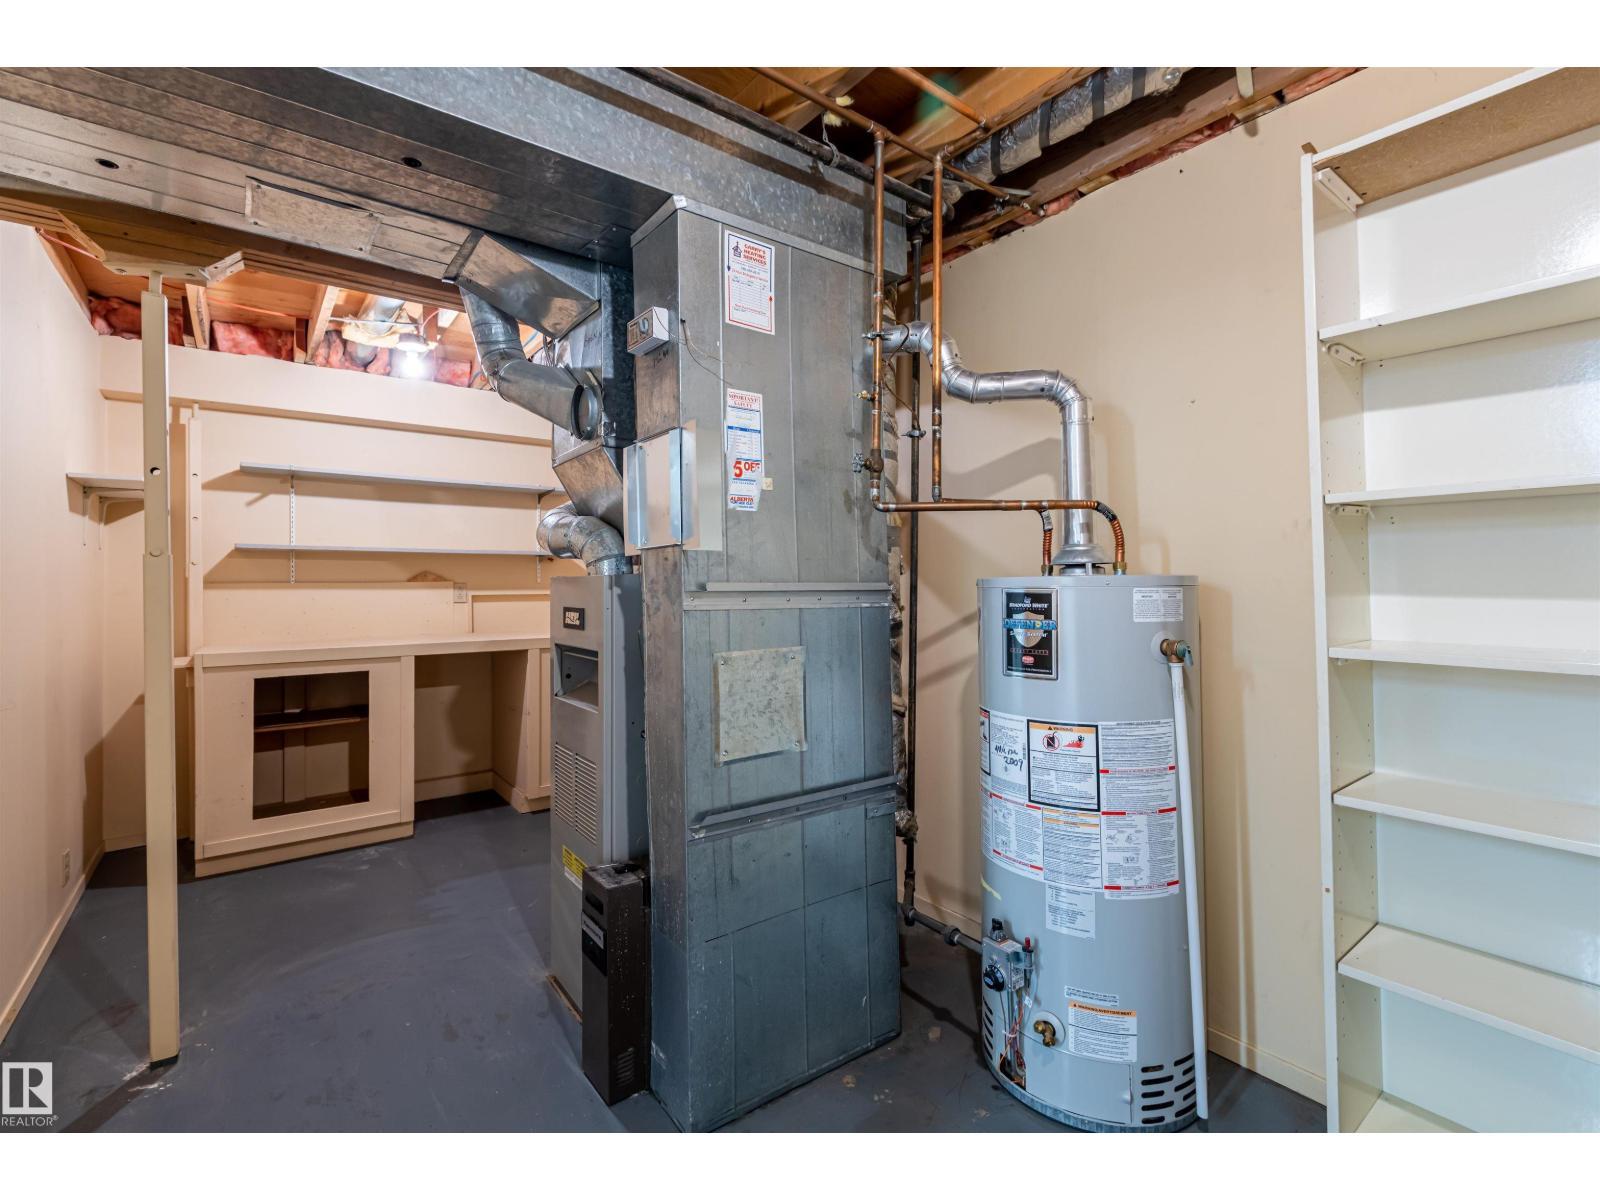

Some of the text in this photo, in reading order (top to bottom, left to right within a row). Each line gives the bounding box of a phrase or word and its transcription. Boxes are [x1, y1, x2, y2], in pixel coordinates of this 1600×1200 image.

[743, 254, 767, 266] SERVICES
[744, 249, 766, 260] HEATING
[1003, 618, 1057, 631] DEFENDER
[1003, 755, 1024, 772] 2009
